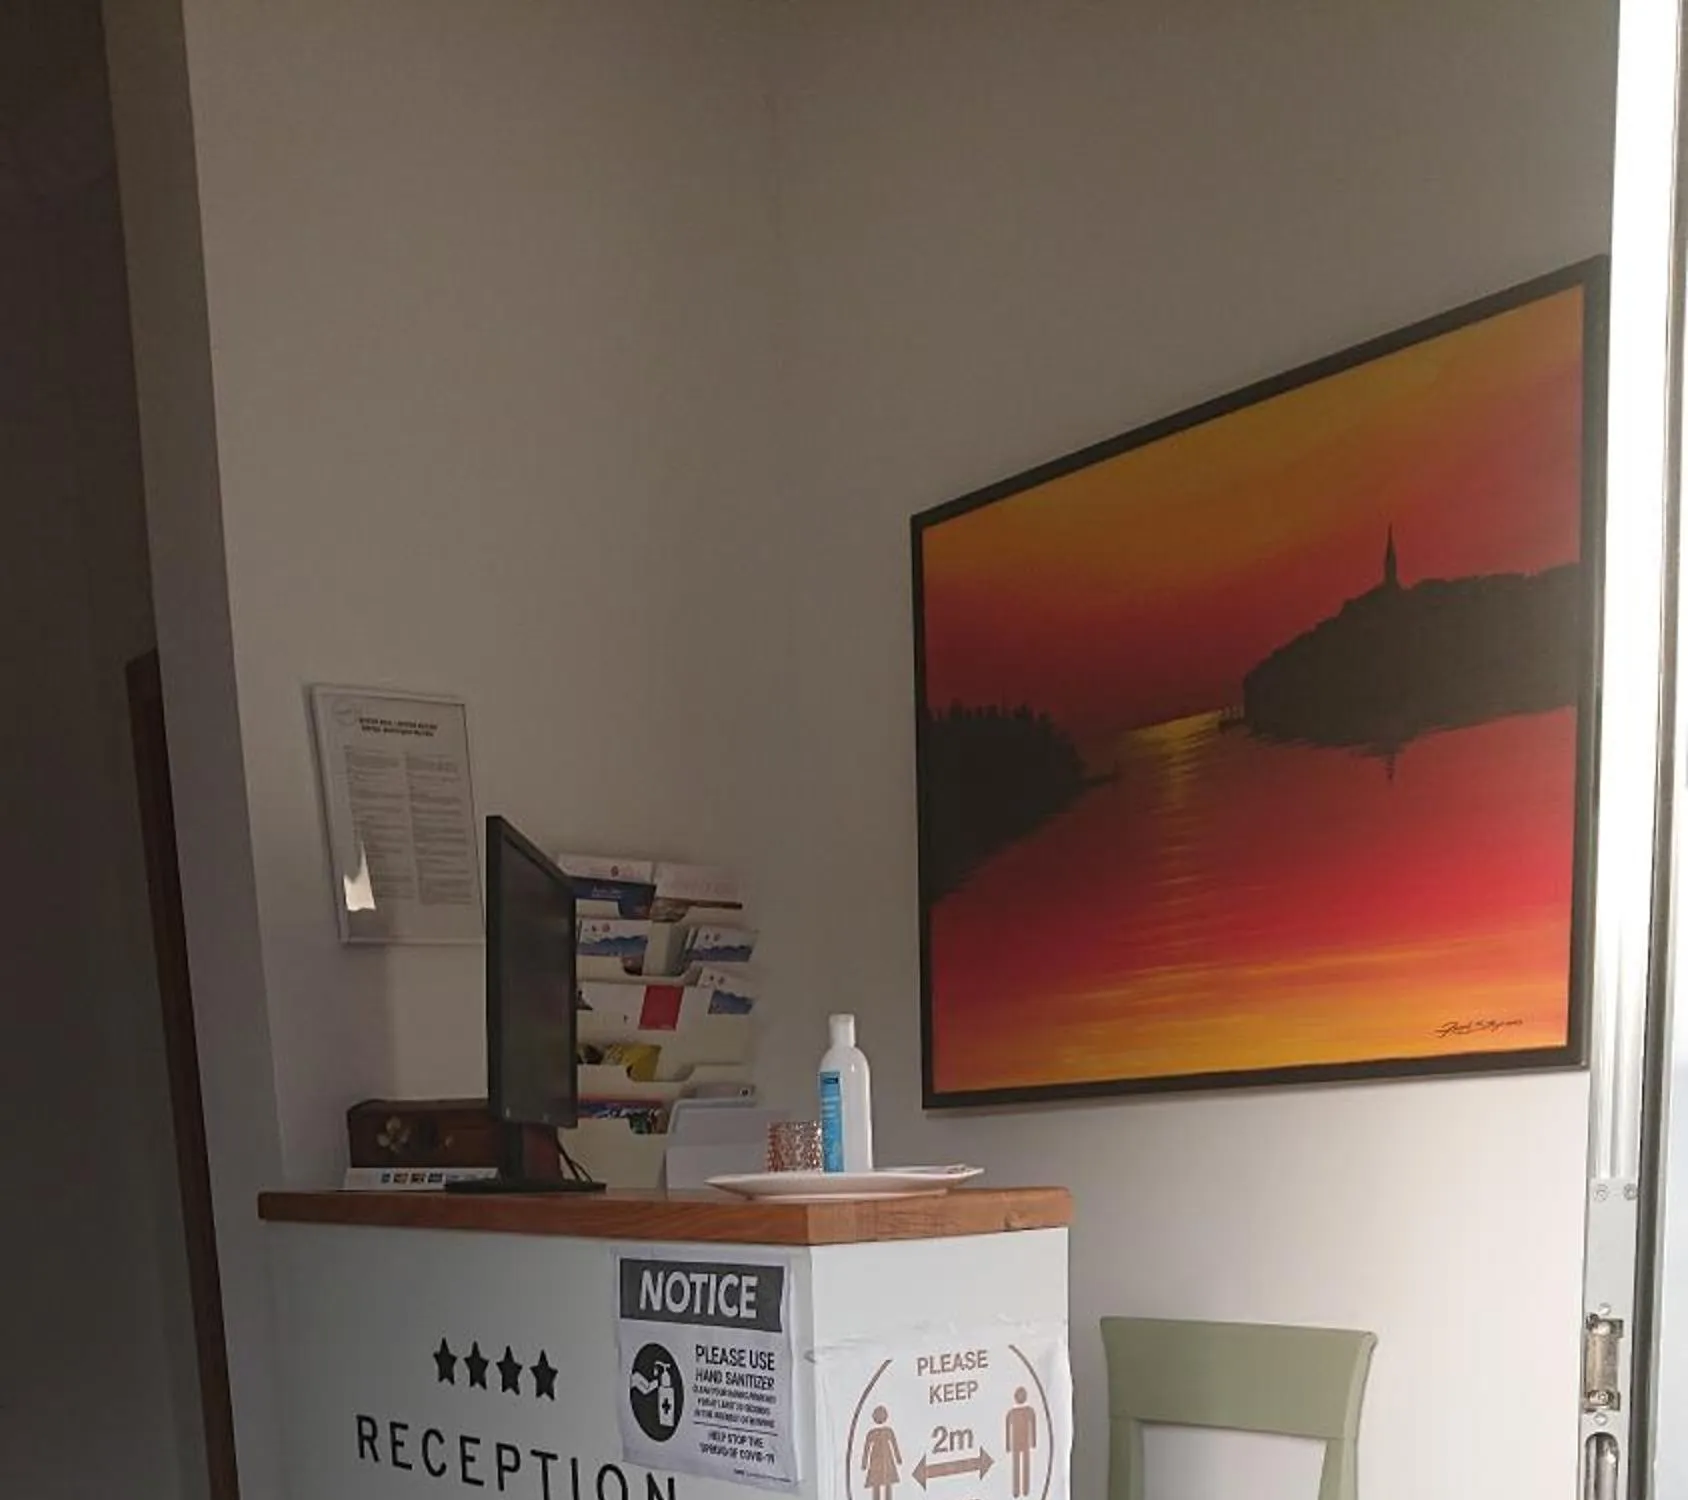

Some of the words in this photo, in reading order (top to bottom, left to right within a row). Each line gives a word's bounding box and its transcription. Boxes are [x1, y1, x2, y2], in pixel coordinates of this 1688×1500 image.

[639, 1269, 758, 1319] NOTICE
[695, 1344, 747, 1368] PLEASE
[749, 1350, 776, 1371] USE
[917, 1349, 989, 1377] PLEASE
[695, 1367, 723, 1386] HAND
[725, 1371, 775, 1392] SANITIZER
[929, 1380, 979, 1405] KEEP
[931, 1425, 975, 1454] 2m
